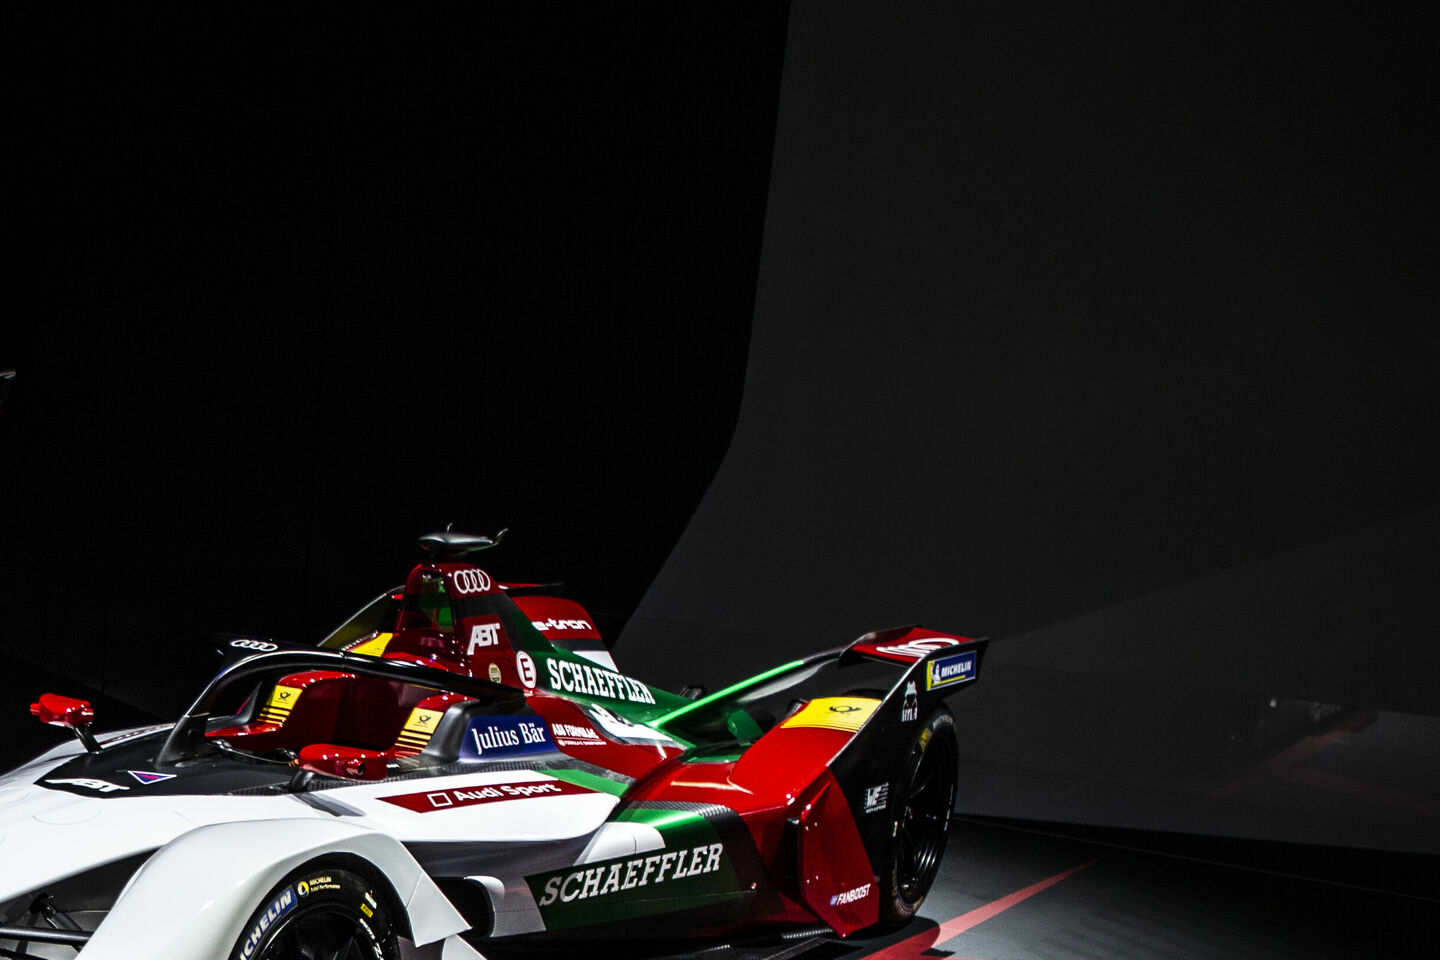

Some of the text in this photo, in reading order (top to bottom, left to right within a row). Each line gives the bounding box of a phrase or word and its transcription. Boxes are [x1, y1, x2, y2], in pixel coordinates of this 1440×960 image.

[467, 622, 501, 656] ABT
[531, 618, 593, 632] e-tron
[546, 657, 656, 705] SCHAEFFLER
[941, 660, 973, 678] MICHELIN
[471, 722, 547, 755] Julius Bär
[453, 783, 562, 801] Audi Sport
[539, 842, 725, 907] SCHAEFFLER
